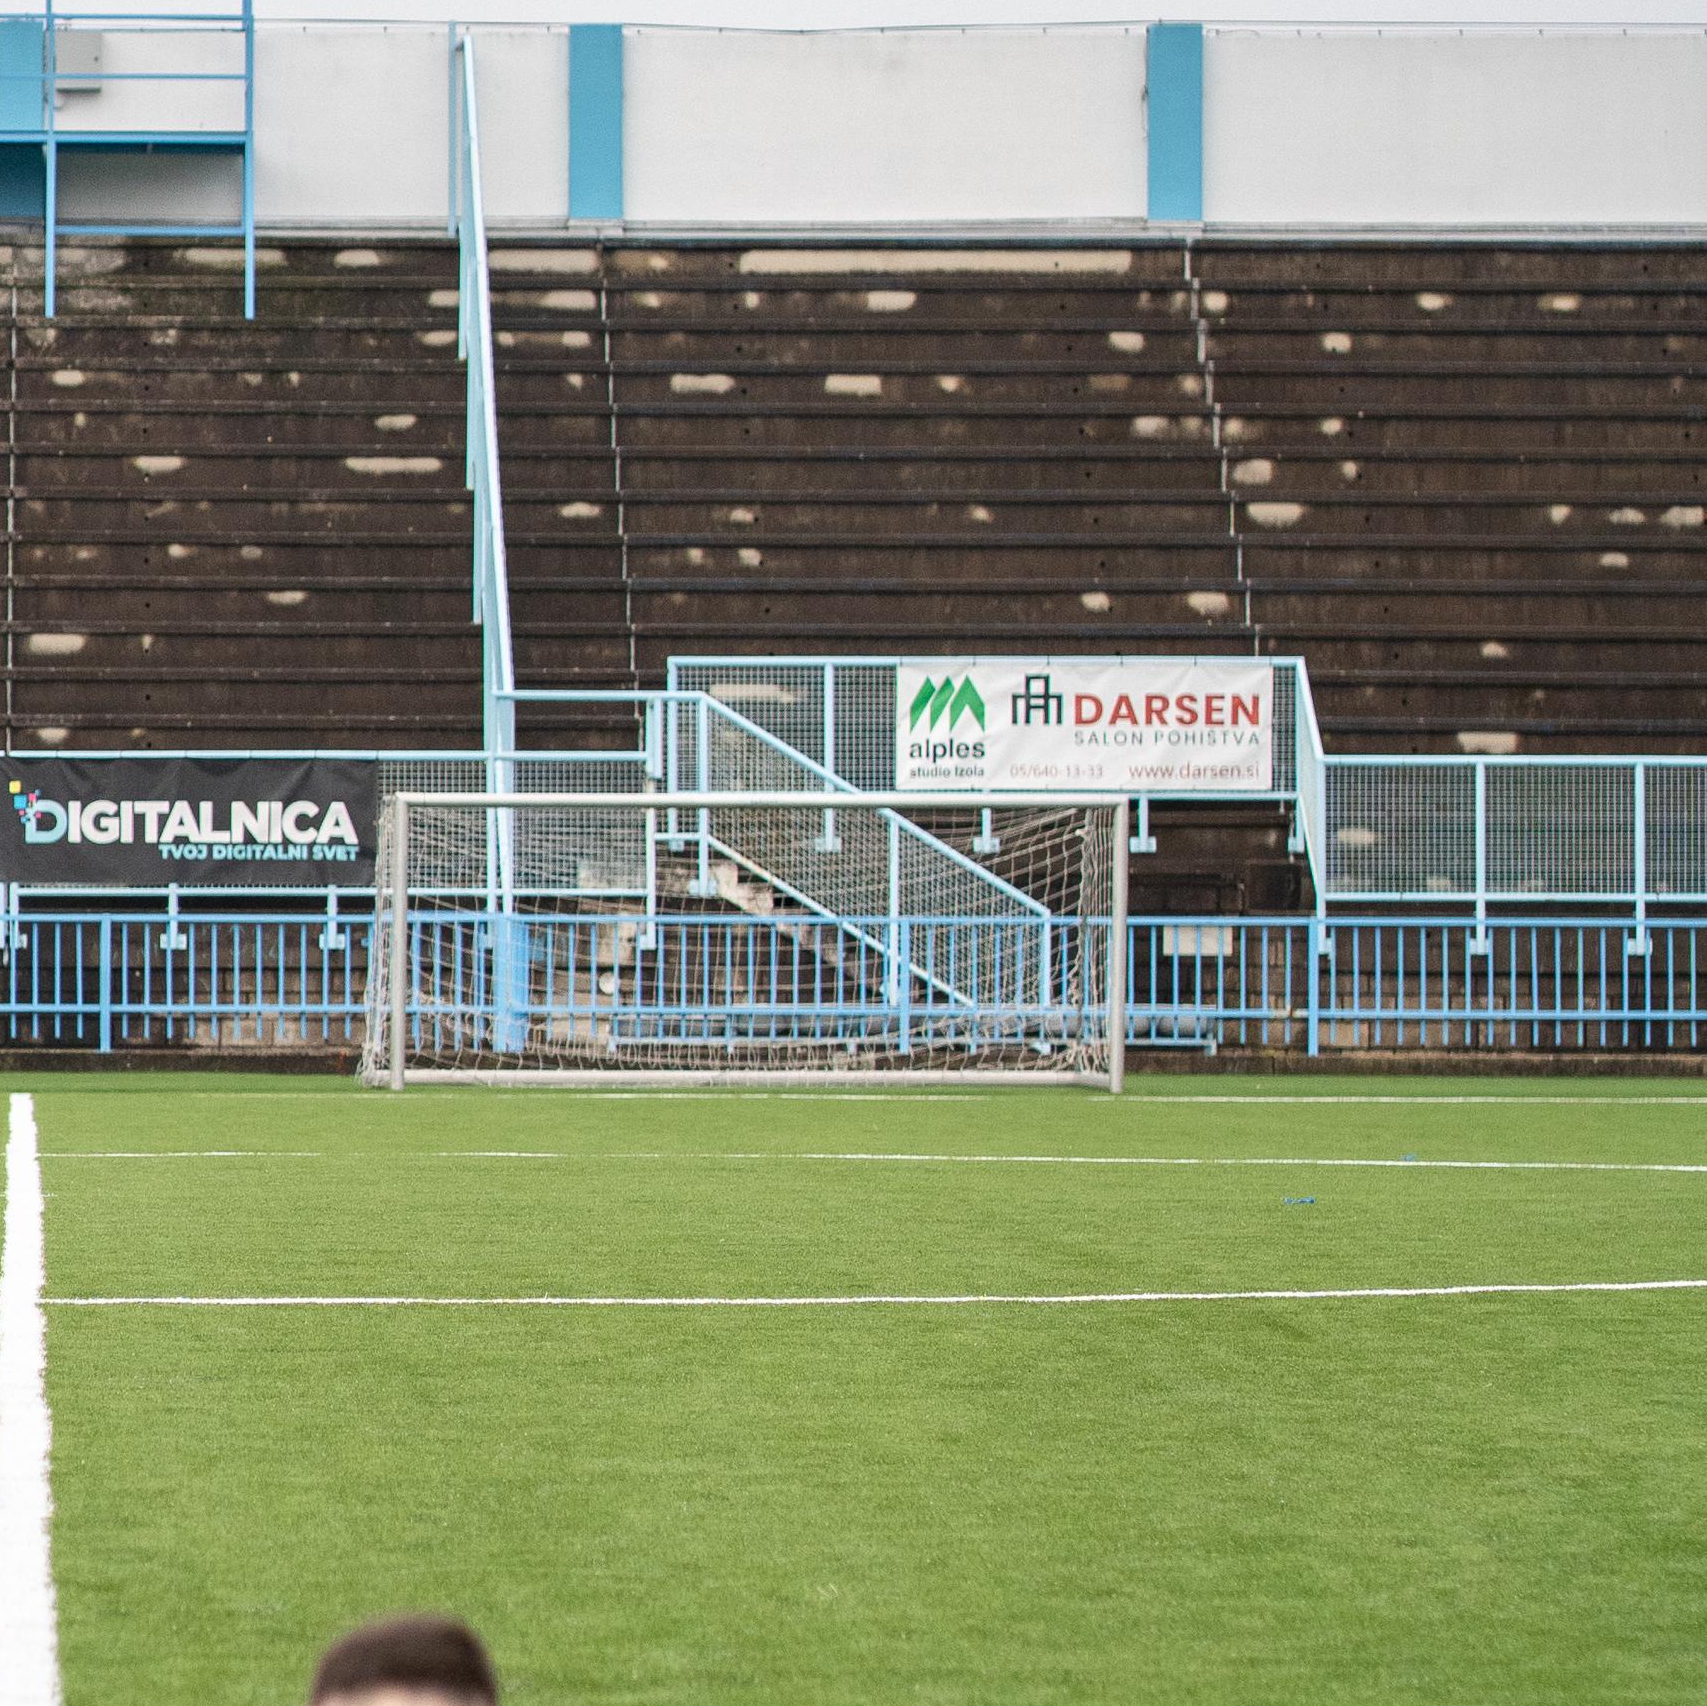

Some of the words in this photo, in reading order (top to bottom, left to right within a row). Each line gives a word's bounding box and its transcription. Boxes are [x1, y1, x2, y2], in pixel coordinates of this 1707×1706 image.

[1074, 694, 1260, 725] DARSEN
[1074, 730, 1143, 747] SALON
[909, 738, 985, 763] alples
[1128, 761, 1260, 780] www.darsen.si
[25, 799, 359, 844] DIGITALNICA
[158, 844, 207, 861] TVOJ
[213, 844, 308, 861] DIGITALNI
[312, 844, 359, 861] SVET
